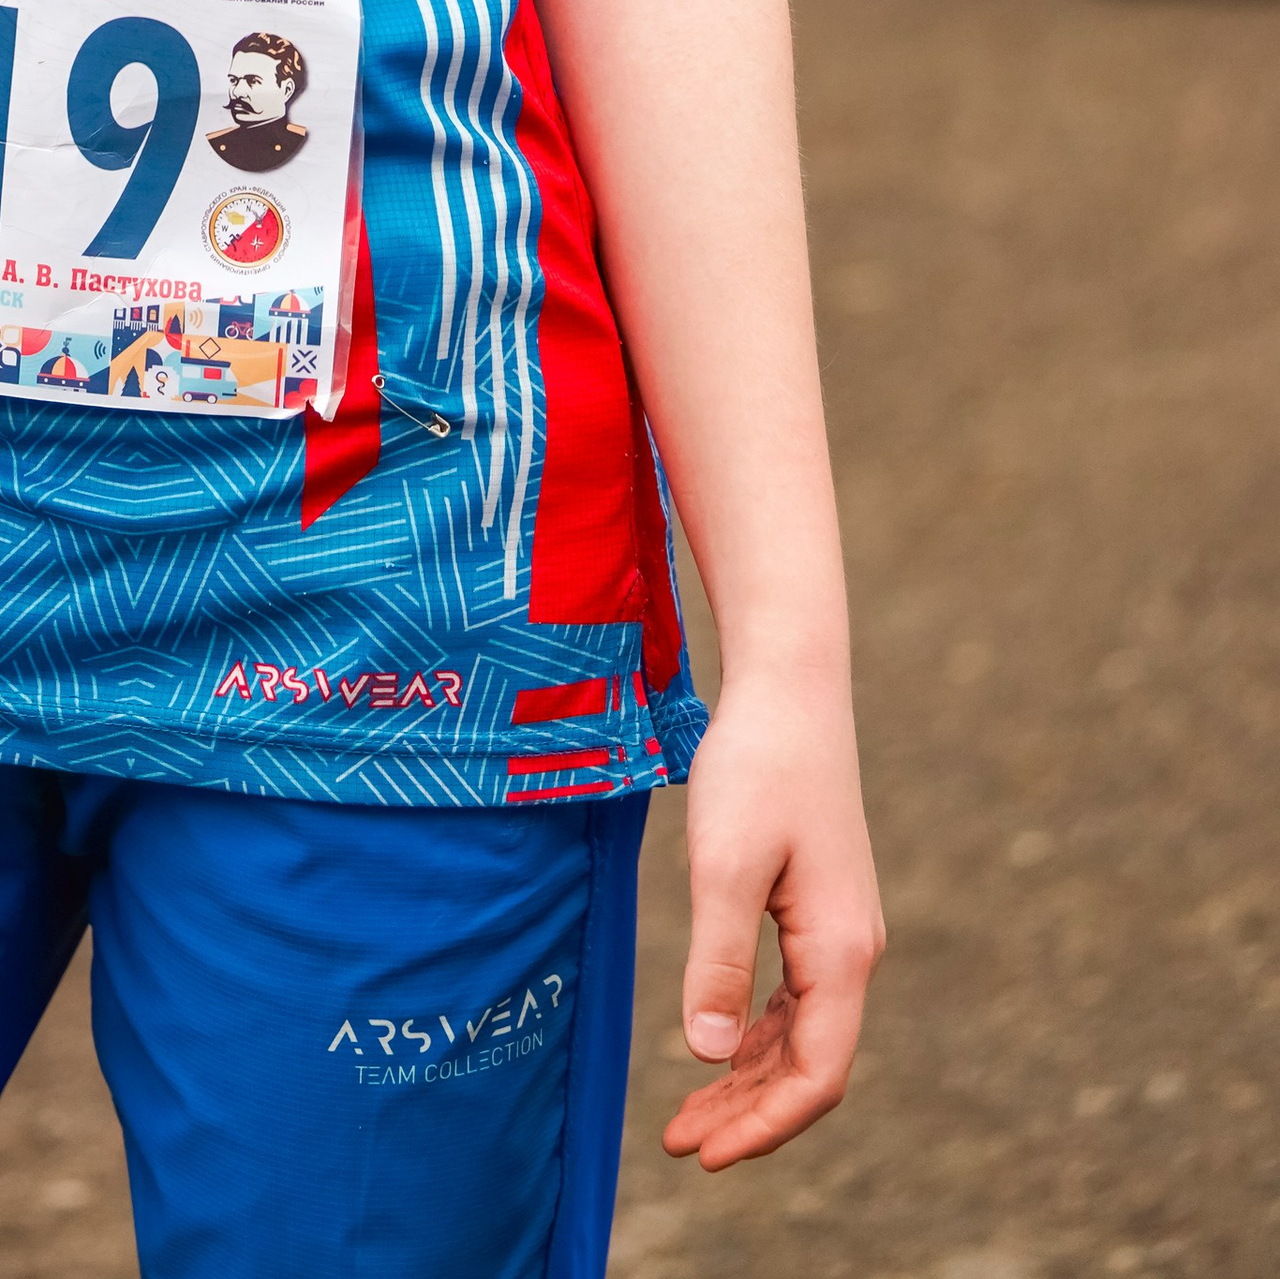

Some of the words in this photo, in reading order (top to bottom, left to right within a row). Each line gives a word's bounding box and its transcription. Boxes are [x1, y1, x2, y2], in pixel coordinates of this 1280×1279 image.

[1, 259, 24, 283] А.
[36, 264, 59, 288] В.
[70, 268, 203, 302] Пастухова
[215, 660, 463, 710] ARSWEAR
[327, 973, 563, 1056] ARSWEAR
[355, 1065, 416, 1085] TEAM
[425, 1028, 543, 1082] COLLECTION
